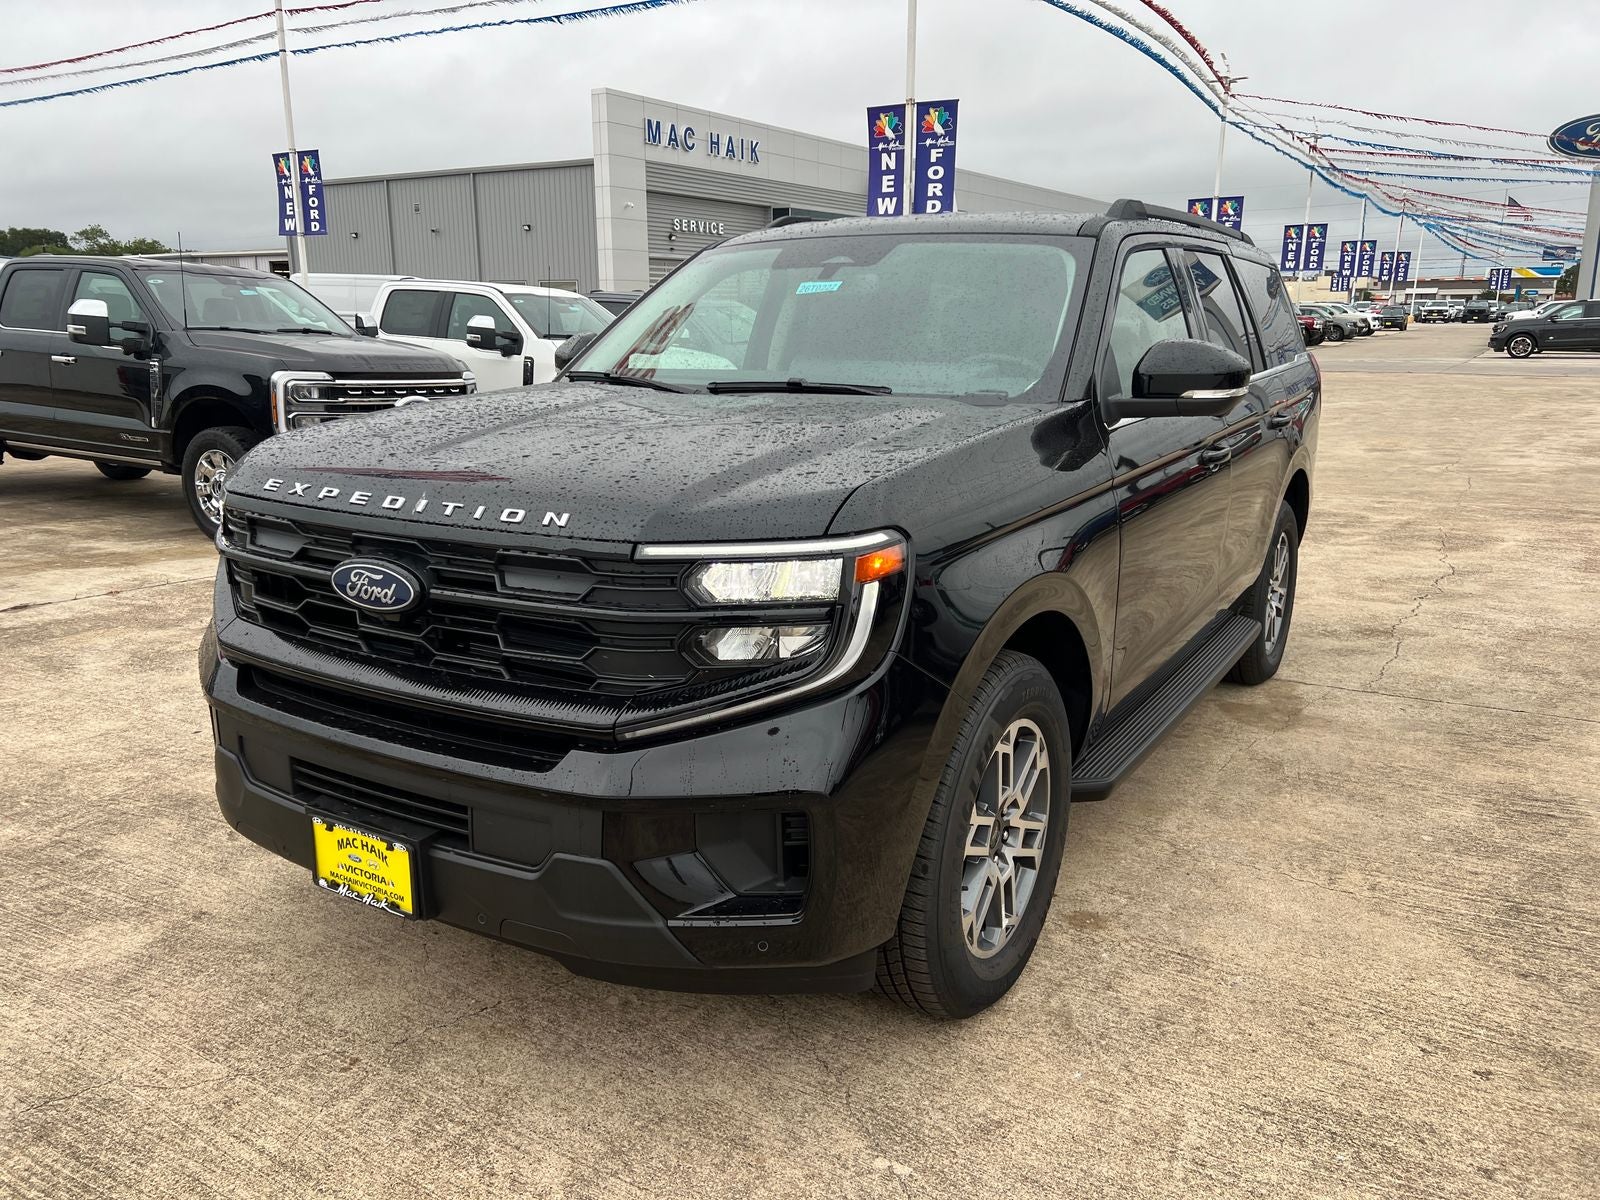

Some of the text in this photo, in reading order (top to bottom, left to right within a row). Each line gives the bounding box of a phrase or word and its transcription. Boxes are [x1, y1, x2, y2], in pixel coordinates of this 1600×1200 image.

[646, 118, 761, 164] MAC HAIK
[877, 152, 897, 215] NEW
[926, 148, 945, 214] FORD
[284, 185, 296, 231] NEW
[308, 184, 320, 232] FORD
[673, 218, 725, 235] SERVICE
[1285, 242, 1297, 269] NEW
[1309, 242, 1319, 269] FORD
[1342, 255, 1351, 276] NEW
[1361, 254, 1370, 276] FORD
[1381, 263, 1390, 281] NEW
[263, 478, 572, 528] EXPEDITION
[346, 569, 397, 604] Ford
[337, 837, 359, 851] MAC
[361, 839, 389, 867] HAIK
[329, 870, 405, 902] MACHAIKVICTORIA.COM
[344, 863, 387, 886] VICTORIA
[336, 883, 394, 911] Mac Haik
